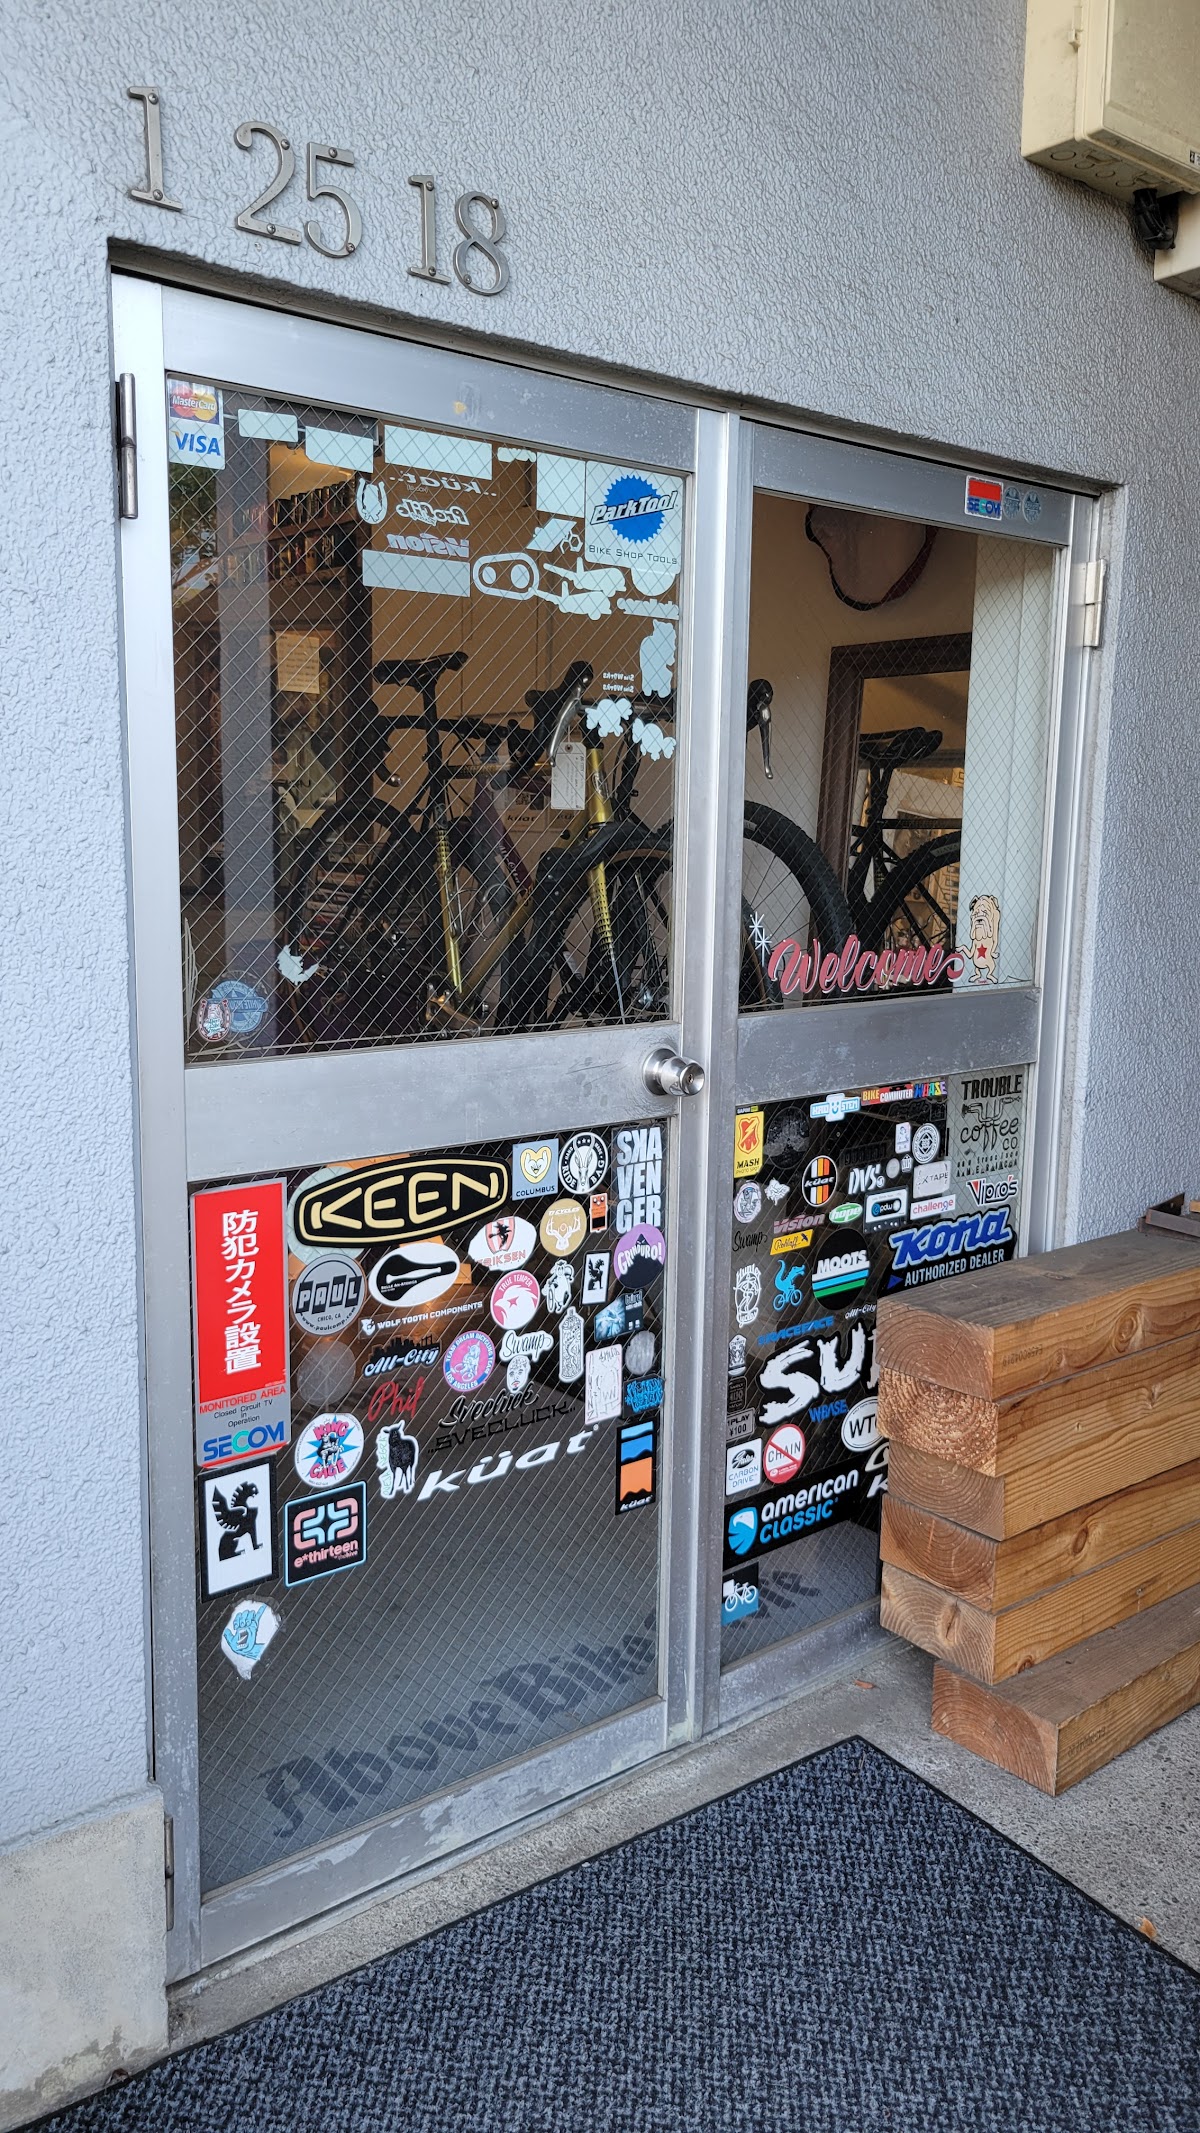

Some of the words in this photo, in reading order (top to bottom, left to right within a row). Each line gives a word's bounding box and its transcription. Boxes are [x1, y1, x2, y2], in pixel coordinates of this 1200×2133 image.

[127, 86, 183, 211] 1
[234, 120, 363, 258] 25
[408, 175, 510, 296] 18
[172, 393, 217, 412] MasterCard
[172, 431, 221, 456] VISA
[590, 491, 678, 525] ParkTool
[968, 497, 1001, 517] SECOM
[589, 545, 611, 556] BIKE
[616, 548, 643, 560] SHOP
[647, 553, 678, 565] TOOLS
[768, 934, 965, 995] Welcome
[862, 1089, 880, 1101] BIKE
[880, 1089, 913, 1102] COMMUTER
[961, 1074, 1022, 1100] TROUBLE
[841, 1100, 858, 1110] STEM
[960, 1116, 1019, 1152] coffee
[736, 1158, 760, 1169] MASH
[562, 1165, 577, 1188] RIDE
[616, 1161, 661, 1200] VEN
[805, 1177, 835, 1187] küat
[311, 1172, 499, 1230] KEEN
[516, 1185, 555, 1197] COLUMBUS
[830, 1206, 860, 1221] hope
[879, 1202, 893, 1213] pdw
[913, 1198, 953, 1212] challenge
[774, 1214, 825, 1234] Vision
[732, 1230, 767, 1252] Swamp
[617, 1242, 663, 1275] GRINDURO!
[817, 1250, 867, 1275] MOOTS
[905, 1260, 967, 1287] AUTHORIZED
[970, 1249, 1004, 1270] DEALER
[221, 1209, 261, 1375] 防犯カメラ設置
[498, 1277, 513, 1292] TRUE
[513, 1274, 532, 1287] TEMPER
[297, 1279, 360, 1311] PAUL
[378, 1319, 401, 1329] WOLF
[403, 1314, 429, 1324] TOOTH
[430, 1301, 482, 1317] COMPONENTS
[504, 1332, 552, 1358] Swamp
[364, 1349, 439, 1376] All-City
[200, 1393, 256, 1414] MONITORED
[261, 1386, 286, 1399] AREA
[214, 1408, 237, 1418] Closed
[240, 1402, 261, 1412] Circuit
[368, 1377, 424, 1421] Phil
[228, 1415, 260, 1428] Operation
[313, 1420, 349, 1440] KING
[729, 1424, 747, 1436] ¥100
[204, 1421, 284, 1461] SECOM
[768, 1441, 801, 1464] CHAIN
[310, 1458, 346, 1479] CAGE
[417, 1428, 596, 1501] küat
[728, 1465, 759, 1480] CARBON
[732, 1475, 754, 1488] DRIVE
[761, 1469, 858, 1522] american
